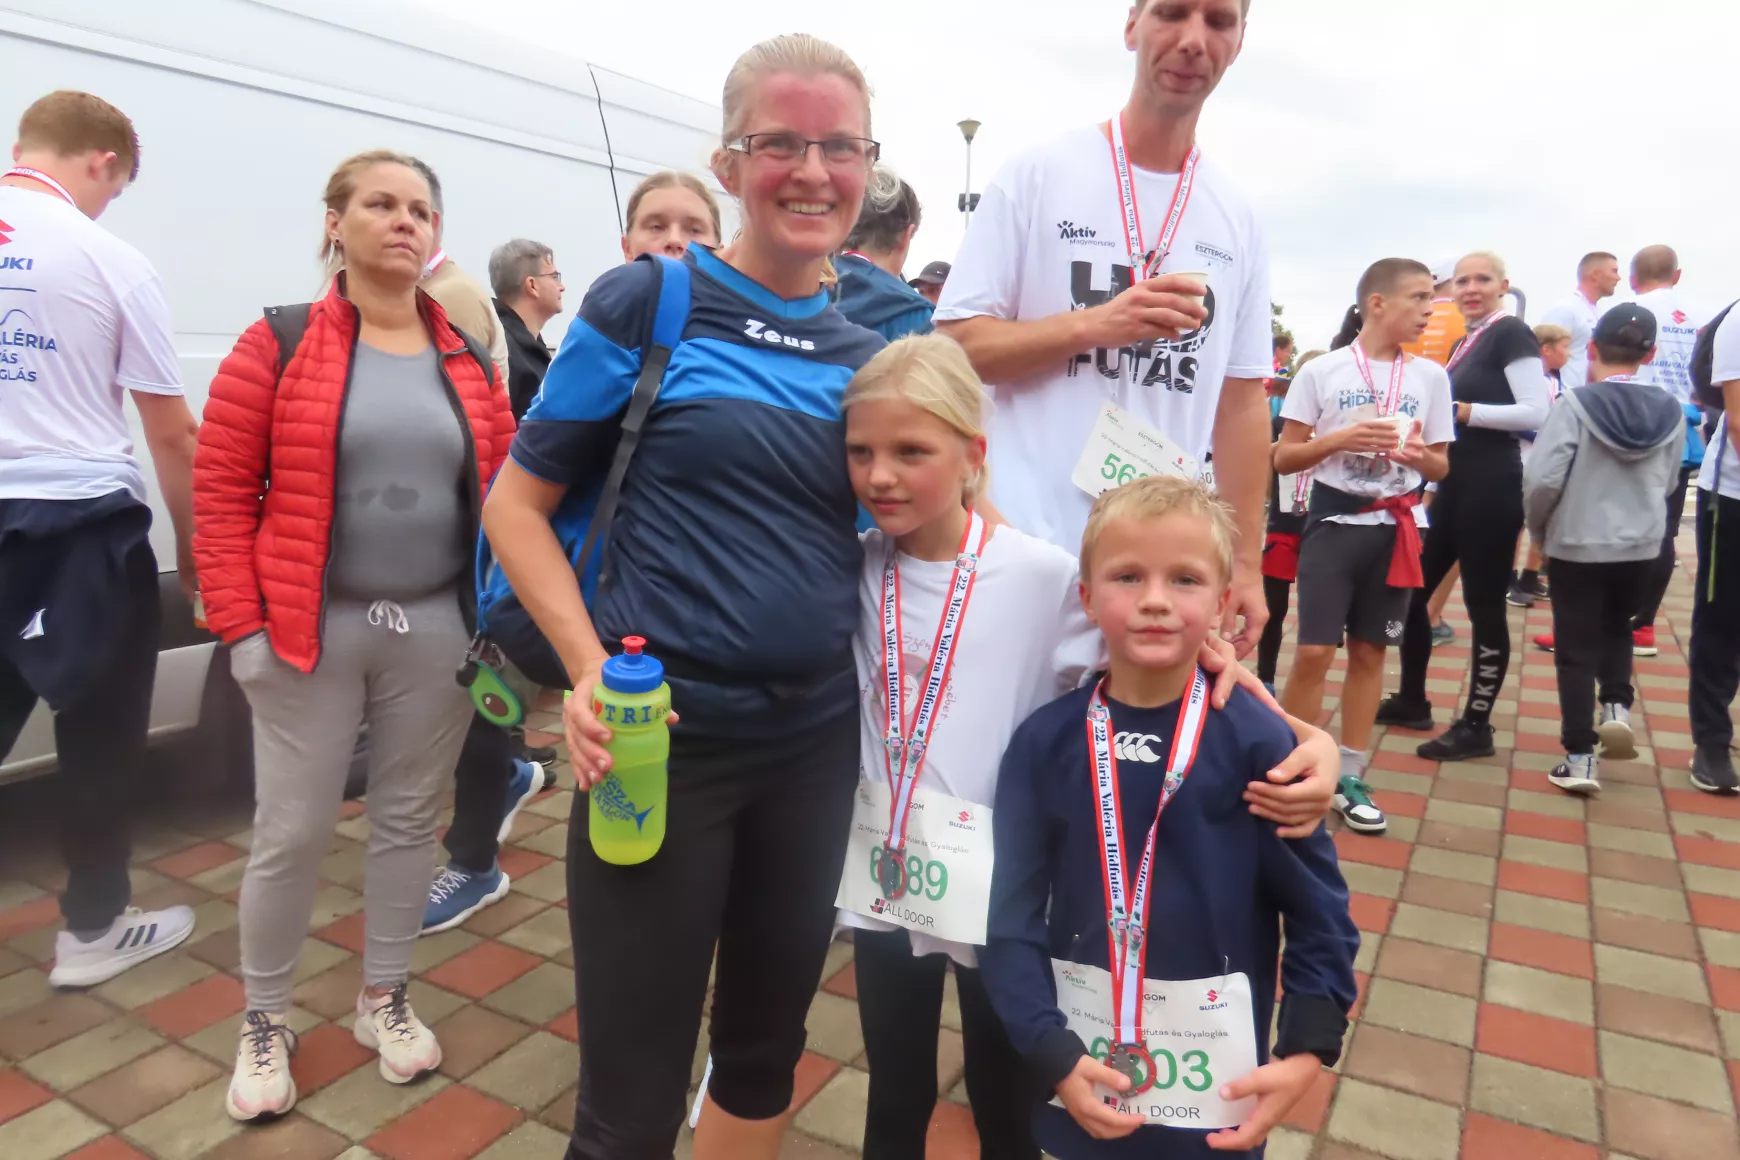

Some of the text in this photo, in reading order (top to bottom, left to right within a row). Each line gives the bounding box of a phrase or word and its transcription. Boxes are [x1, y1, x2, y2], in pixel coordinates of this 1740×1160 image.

[1059, 224, 1097, 240] Aktiv
[0, 327, 58, 353] LÉRIA
[744, 318, 816, 351] Zeus
[955, 573, 968, 592] 22.
[885, 594, 895, 625] Mária
[945, 596, 963, 629] Mária
[886, 628, 899, 668] Valéria
[933, 633, 953, 672] Valéria
[1471, 645, 1500, 712] DKNY
[888, 671, 899, 722] Hídfutás
[917, 676, 941, 725] Hídfutás
[605, 703, 652, 725] TRI
[948, 820, 976, 832] SUZUKI
[1094, 726, 1122, 900] 22. Mária Valéria Hídfutás
[884, 903, 935, 928] ALL DOOR
[1199, 1002, 1228, 1011] SUZUKI
[1184, 1028, 1229, 1039] Gyaloglás
[1150, 1105, 1201, 1119] DOOR
